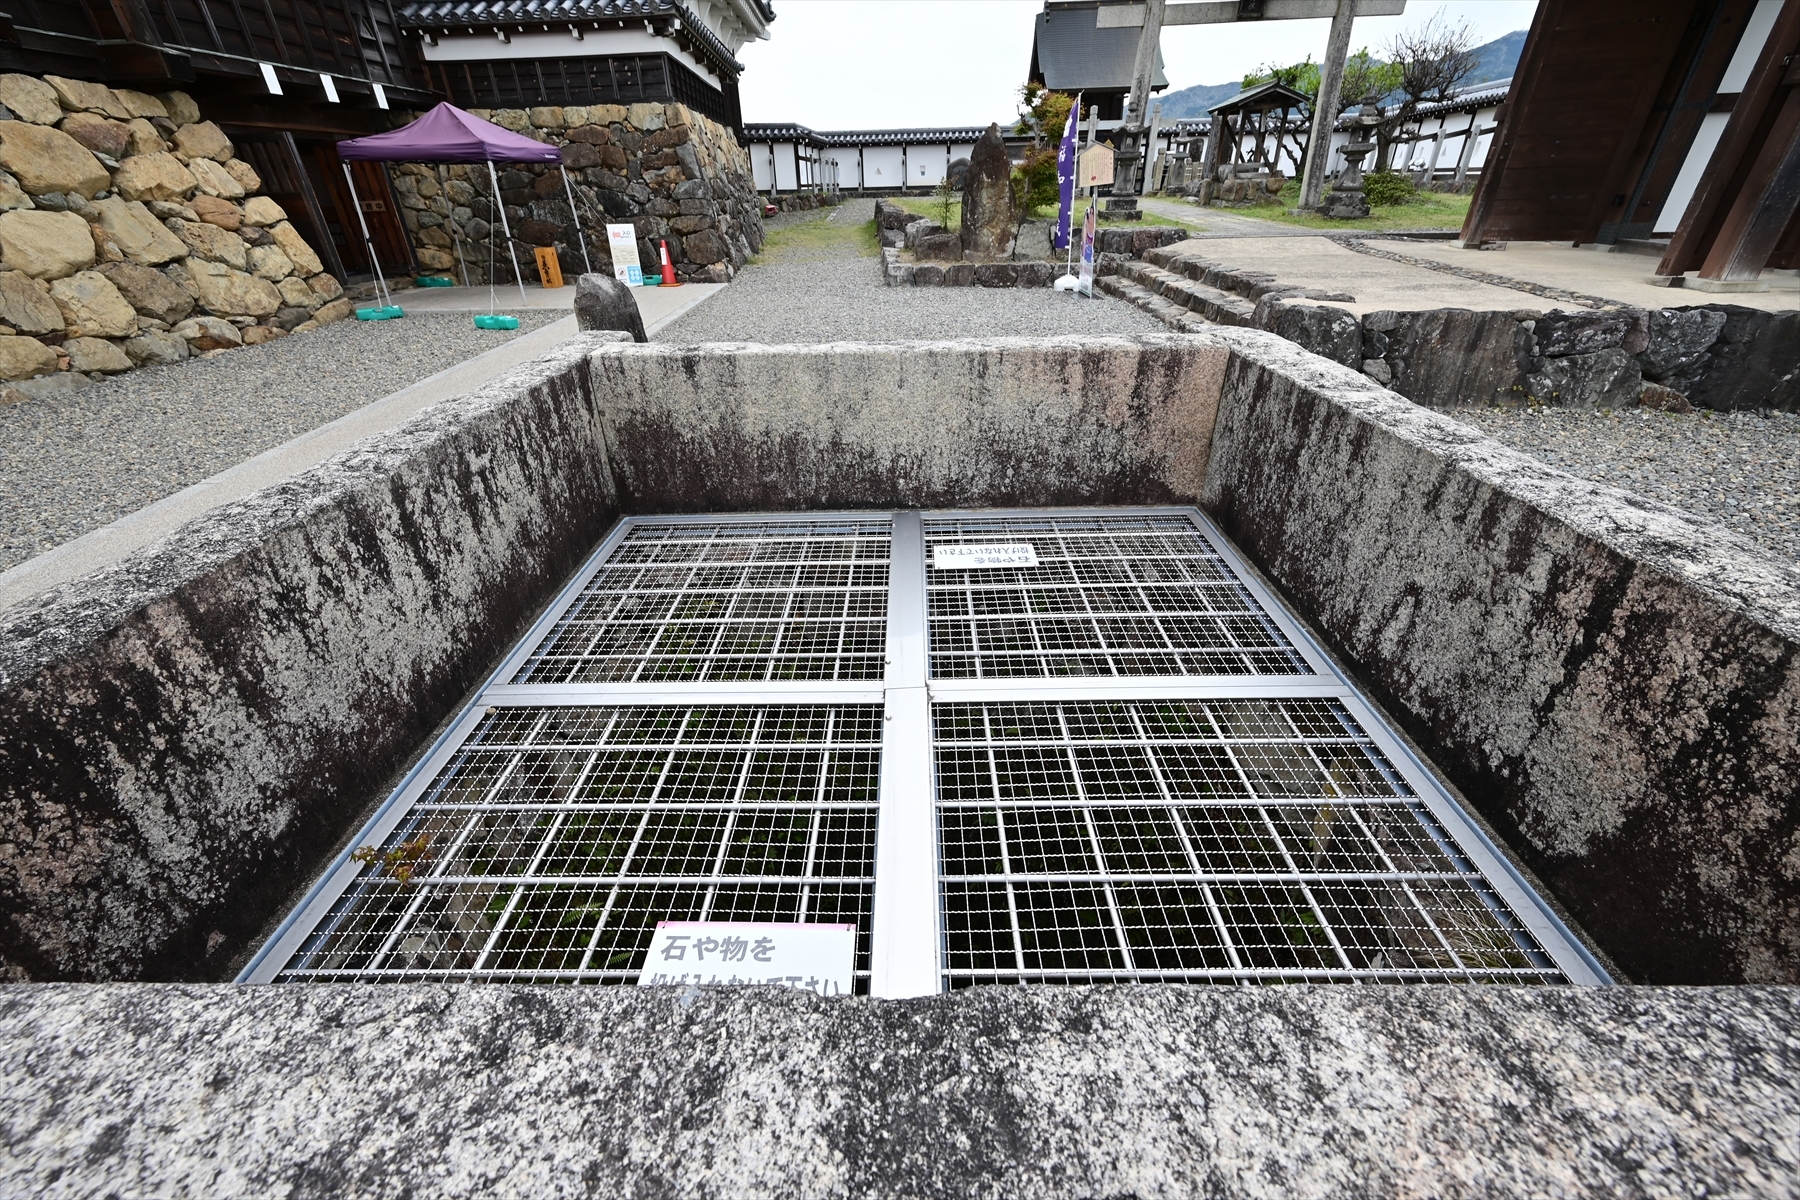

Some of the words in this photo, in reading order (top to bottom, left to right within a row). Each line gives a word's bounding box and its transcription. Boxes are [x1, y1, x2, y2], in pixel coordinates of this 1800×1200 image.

[974, 556, 1031, 564] 石や物を
[661, 935, 776, 962] 石や物を
